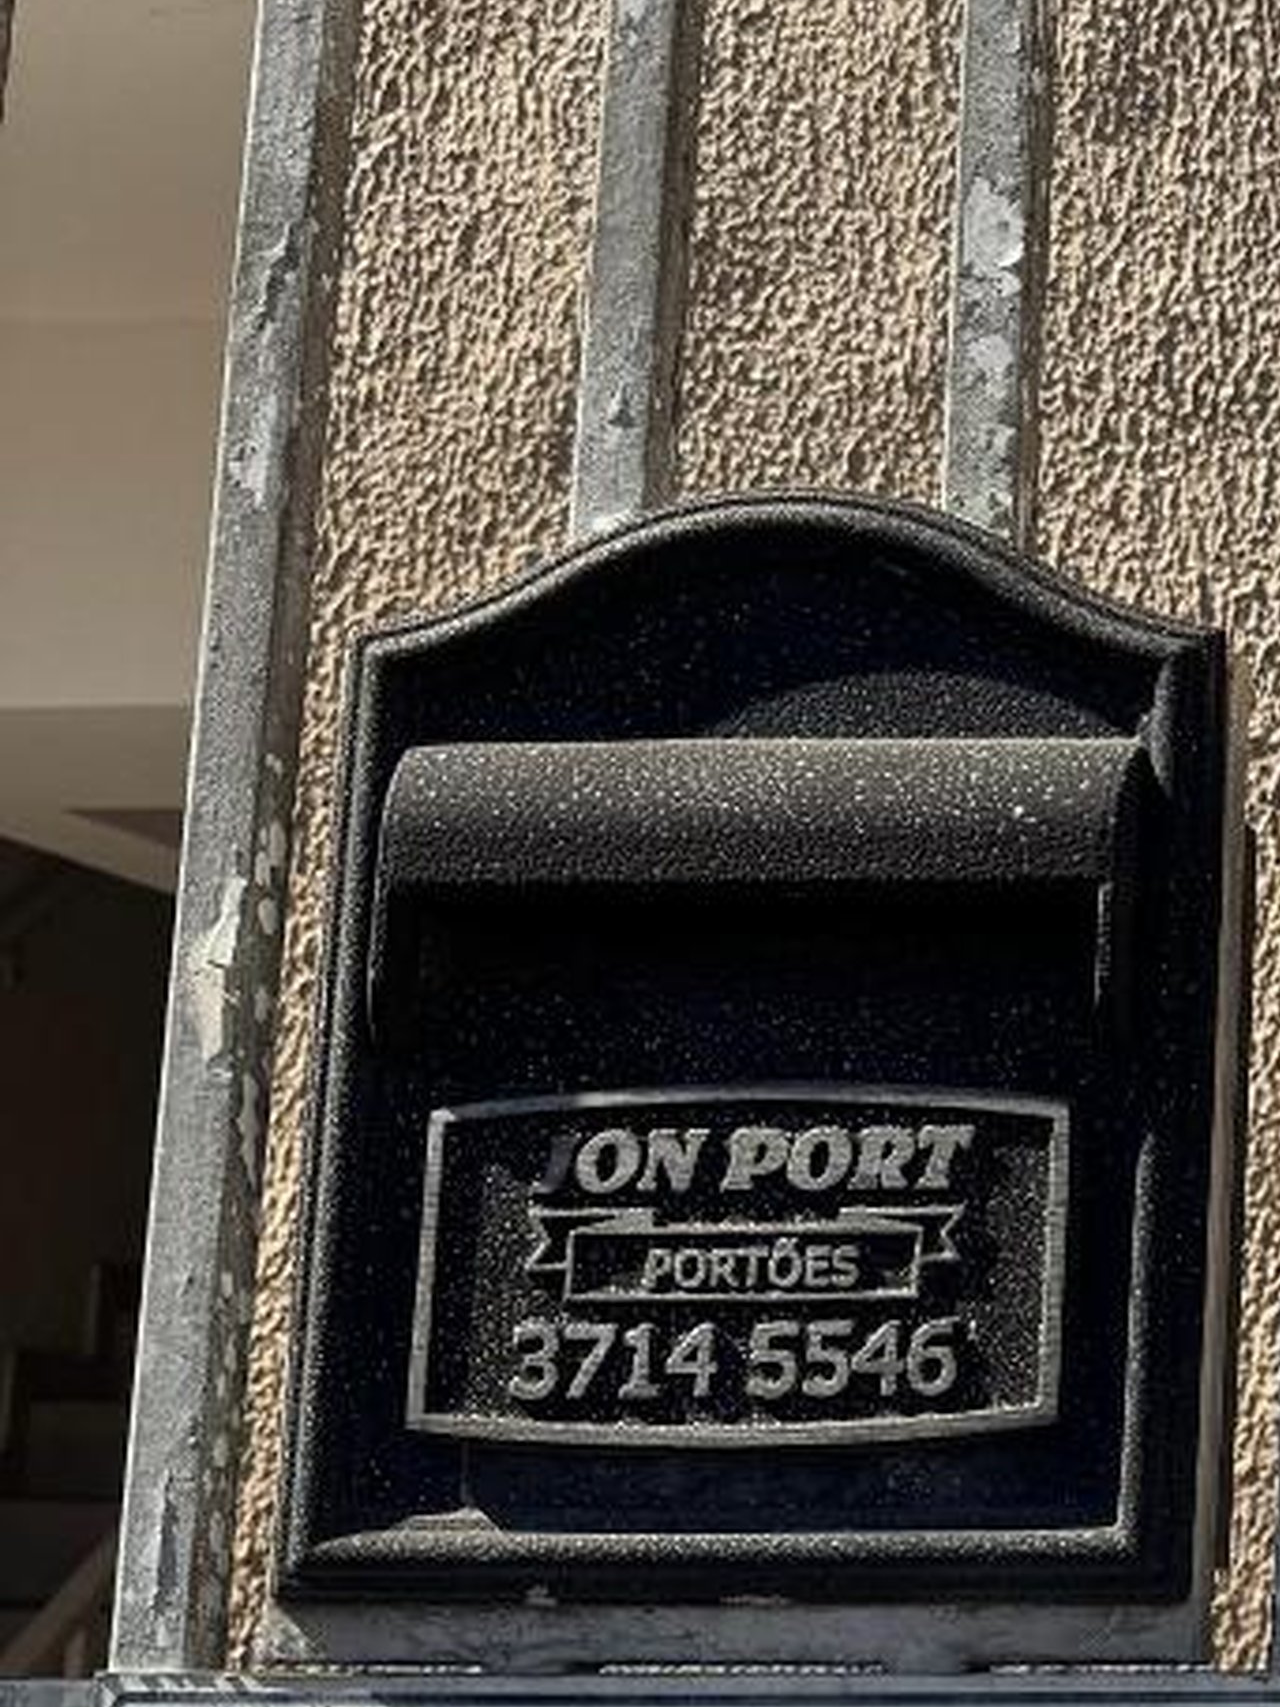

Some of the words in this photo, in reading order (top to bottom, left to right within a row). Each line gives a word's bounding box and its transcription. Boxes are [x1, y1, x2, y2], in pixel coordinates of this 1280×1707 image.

[720, 1124, 975, 1192] PORT
[642, 1236, 861, 1288] PORTÕES
[507, 1321, 718, 1400] 3714
[746, 1316, 961, 1398] 5546
